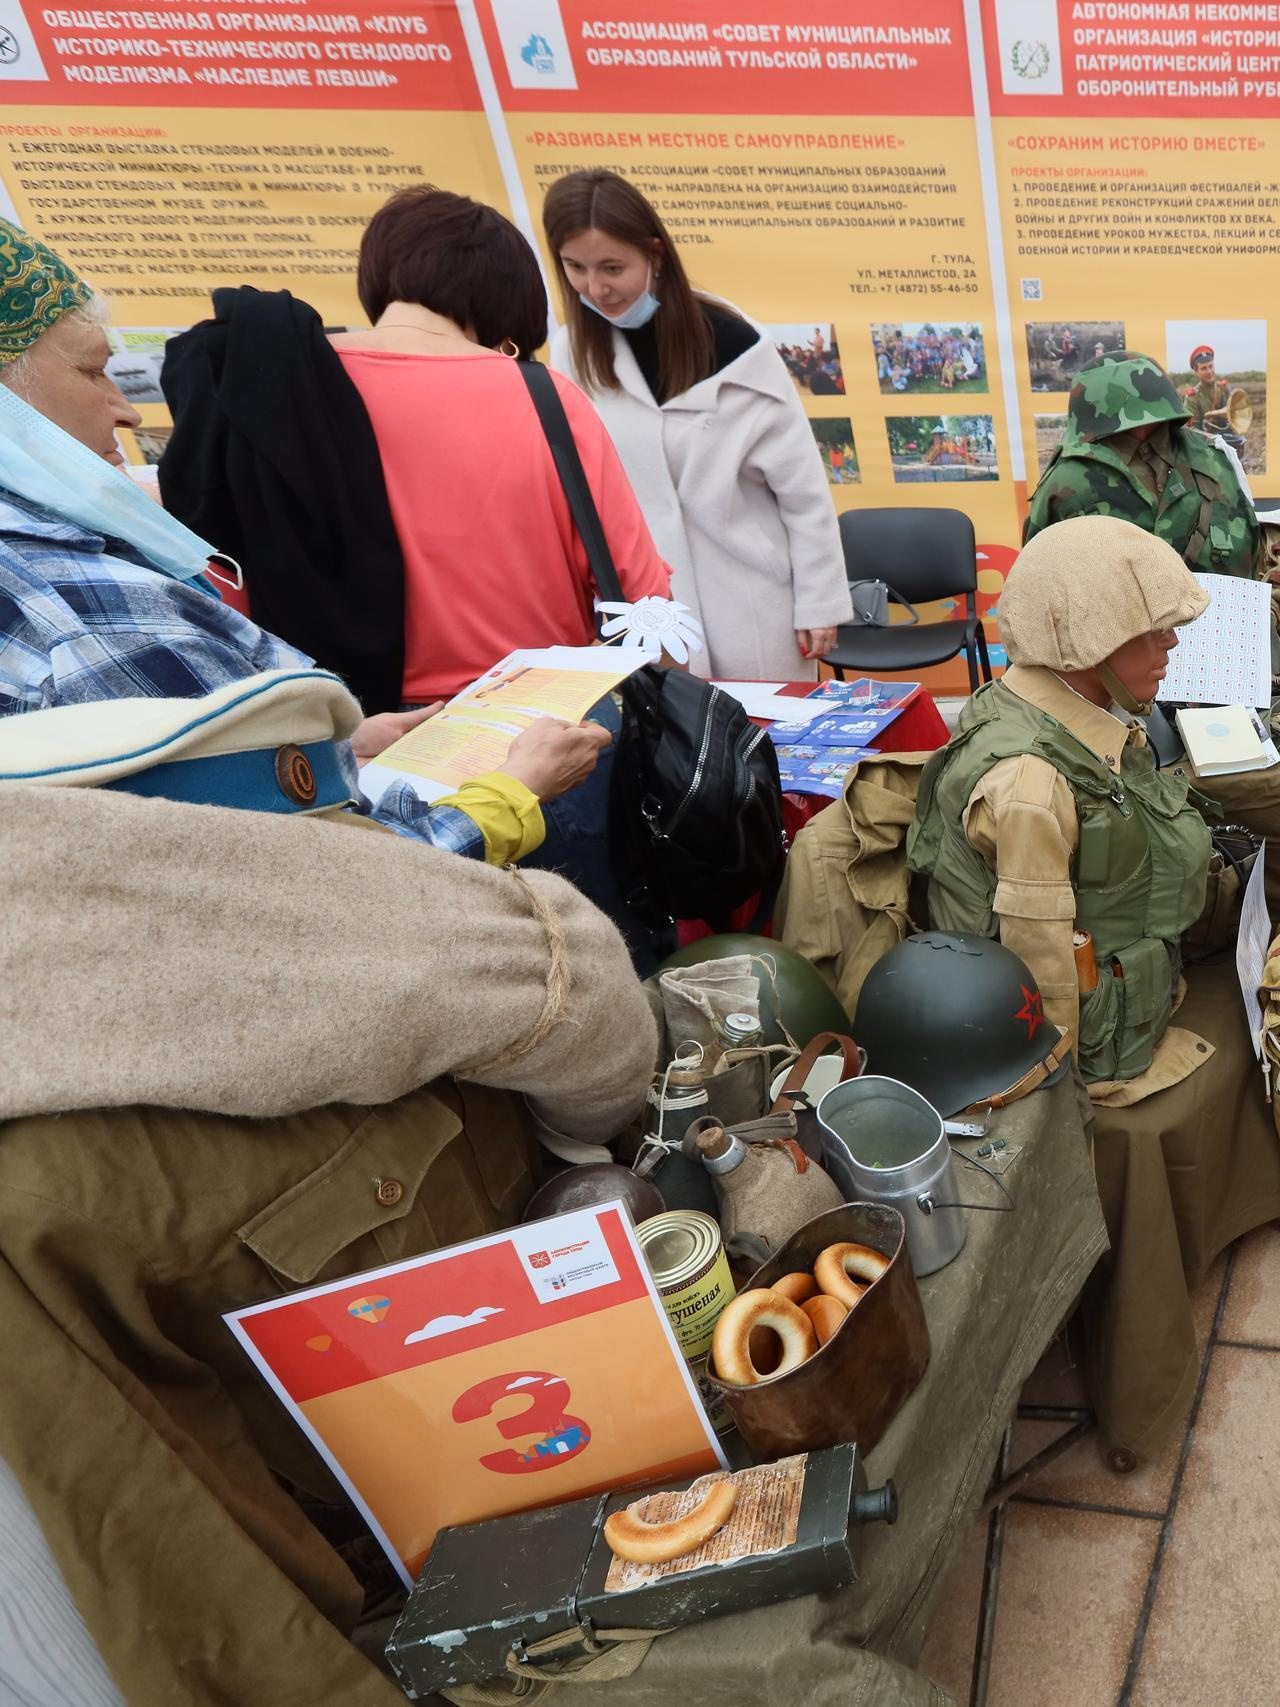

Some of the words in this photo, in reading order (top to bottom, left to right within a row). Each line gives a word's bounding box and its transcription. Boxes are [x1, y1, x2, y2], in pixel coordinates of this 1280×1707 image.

[1072, 4, 1190, 20] АВТОНОМНАЯ
[42, 10, 214, 30] ОБЩЕСТВЕННАЯ
[216, 13, 361, 34] ОРГАНИЗАЦИЯ
[365, 16, 428, 34] «КЛУБ
[581, 21, 708, 42] АССОЦИАЦИЯ
[712, 23, 780, 43] «СОВЕТ
[786, 25, 951, 46] МУНИЦИПАЛЬНЫХ
[1073, 29, 1197, 48] ОРГАНИЗАЦИЯ
[52, 38, 321, 60] ИСТОРИКО-ТЕХНИЧЕСКОГО
[325, 43, 452, 62] СТЕНДОВОГО
[586, 46, 722, 67] ОБРАЗОВАНИЙ
[725, 48, 821, 69] ТУЛЬСКОЙ
[828, 51, 917, 70] ОБЛАСТИ»
[1075, 52, 1232, 73] ПАТРИОТИЧЕСКИЙ
[62, 65, 192, 84] МОДЕЛИЗМА
[195, 67, 312, 87] «НАСЛЕДИЕ
[315, 69, 398, 87] ЛЕВШИ»
[1077, 77, 1239, 97] ОБОРОНИТЕЛЬНЫЙ
[0, 125, 62, 137] ПРОЕКТЫ
[69, 126, 167, 138] ОРГАНИЗАЦИИ:
[526, 132, 642, 147] «РАЗВИВАЕМ
[649, 133, 729, 148] МЕСТНОЕ
[735, 134, 905, 149] САМОУПРАВЛЕНИЕ»
[1008, 136, 1103, 150] «СОХРАНИМ
[1110, 137, 1188, 150] ИСТОРИЮ
[1194, 137, 1265, 150] ВМЕСТЕ»
[8, 143, 19, 153] 1.
[23, 143, 102, 154] ЕЖЕГОДНАЯ
[108, 144, 178, 154] ВЫСТАВКА
[182, 145, 260, 156] СТЕНДОВЫХ
[263, 144, 323, 157] МОДЕЛЕЙ
[328, 146, 335, 156] И
[630, 165, 709, 176] АССОЦИАЦИИ
[712, 166, 753, 176] «СОВЕТ
[758, 166, 862, 177] МУНИЦИПАЛЬНЫХ
[865, 164, 946, 176] ОБРАЗОВАНИЙ
[1011, 167, 1063, 177] ПРОЕКТЫ
[1067, 168, 1148, 178] ОРГАНИЗАЦИИ:
[666, 183, 743, 193] НАПРАВЛЕНА
[746, 183, 762, 193] НА
[765, 184, 848, 195] ОРГАНИЗАЦИЮ
[852, 182, 956, 194] ВЗАИМОДЕЙСТВИЯ
[1013, 183, 1020, 192] 1.
[1024, 183, 1096, 193] ПРОВЕДЕНИЕ
[1100, 183, 1107, 192] И
[1110, 183, 1186, 193] ОРГАНИЗАЦИЯ
[1190, 182, 1261, 193] ФЕСТИВАЛЕЙ
[1014, 199, 1023, 208] 2.
[1026, 198, 1098, 208] ПРОВЕДЕНИЕ
[1102, 196, 1193, 208] РЕКОНСТРУКЦИЙ
[1196, 196, 1254, 207] СРАЖЕНИЙ
[1018, 244, 1068, 255] ВОЕННОЙ
[1072, 246, 1120, 255] ИСТОРИИ
[1123, 246, 1130, 254] И
[1133, 244, 1223, 255] КРАЕВЕДЧЕСКОЙ
[944, 255, 975, 265] ТУЛА,
[858, 270, 875, 279] УЛ.
[879, 269, 960, 279] МЕТАЛЛИСТОВ,
[850, 284, 877, 293] ТЕЛ.:
[880, 284, 891, 293] +7
[895, 284, 927, 294] (4872)
[930, 284, 978, 293] 55-46-50
[451, 1371, 592, 1475] 3
